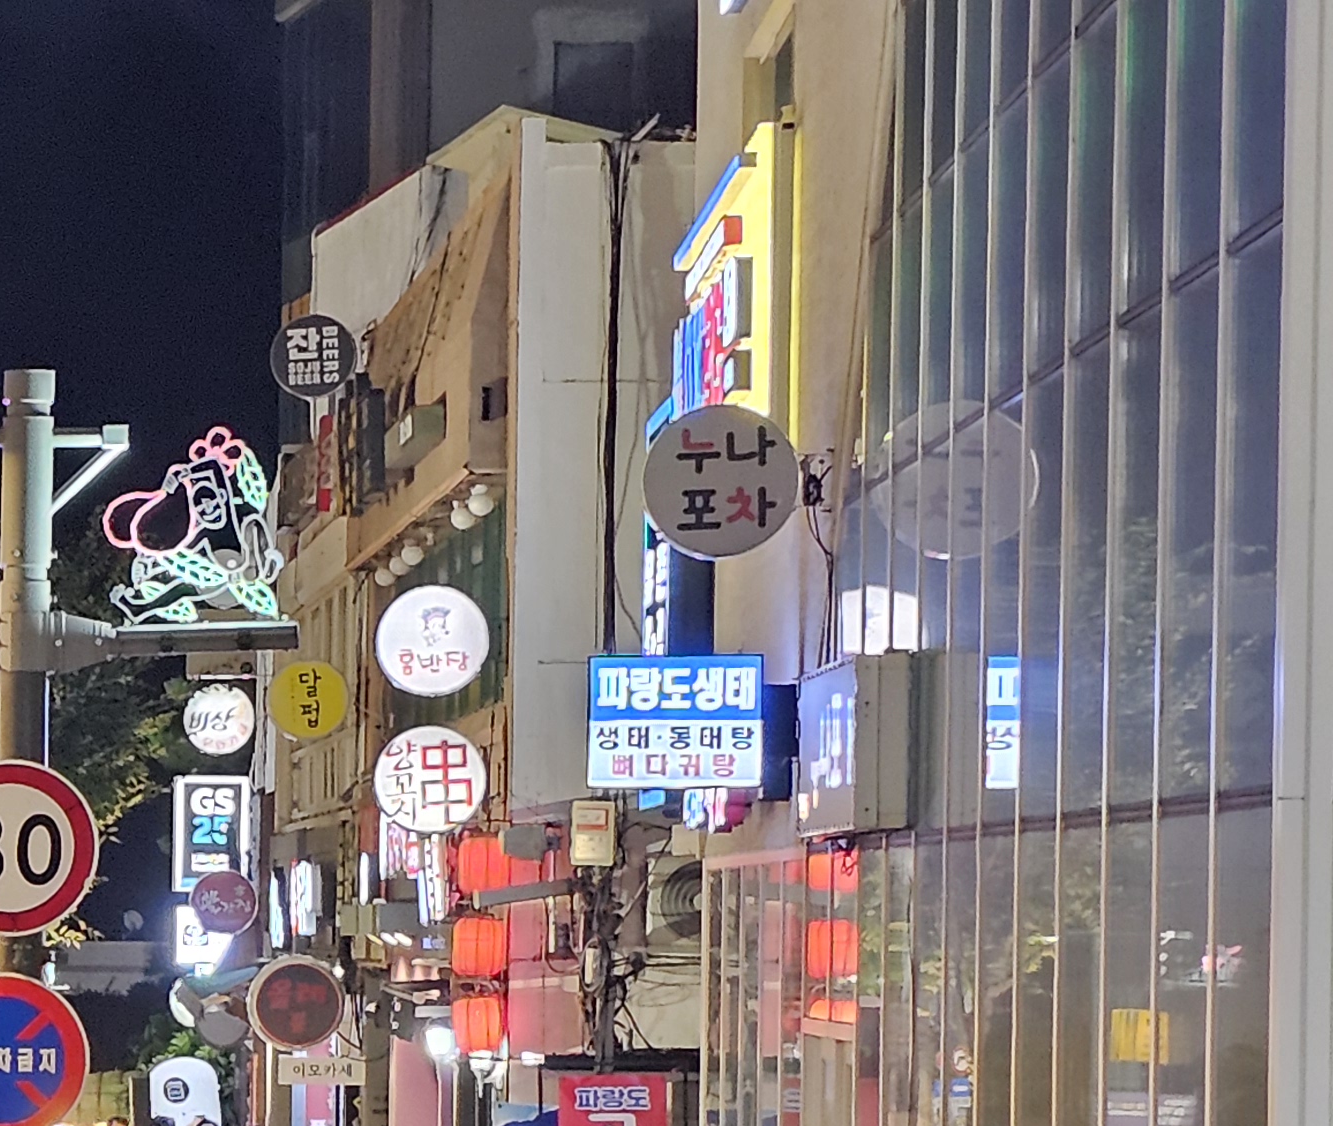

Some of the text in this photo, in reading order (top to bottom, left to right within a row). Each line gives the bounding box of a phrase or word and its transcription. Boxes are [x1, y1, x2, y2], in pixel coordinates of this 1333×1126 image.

[286, 327, 320, 360] 잔
[322, 326, 339, 384] BEERS
[676, 425, 777, 474] 누나
[676, 486, 777, 531] 포차
[596, 667, 757, 711] 파랑도생태
[190, 787, 237, 816] GS
[191, 815, 232, 845] 25
[293, 1063, 353, 1078] 이모카세
[575, 1086, 651, 1111] 파랑도
